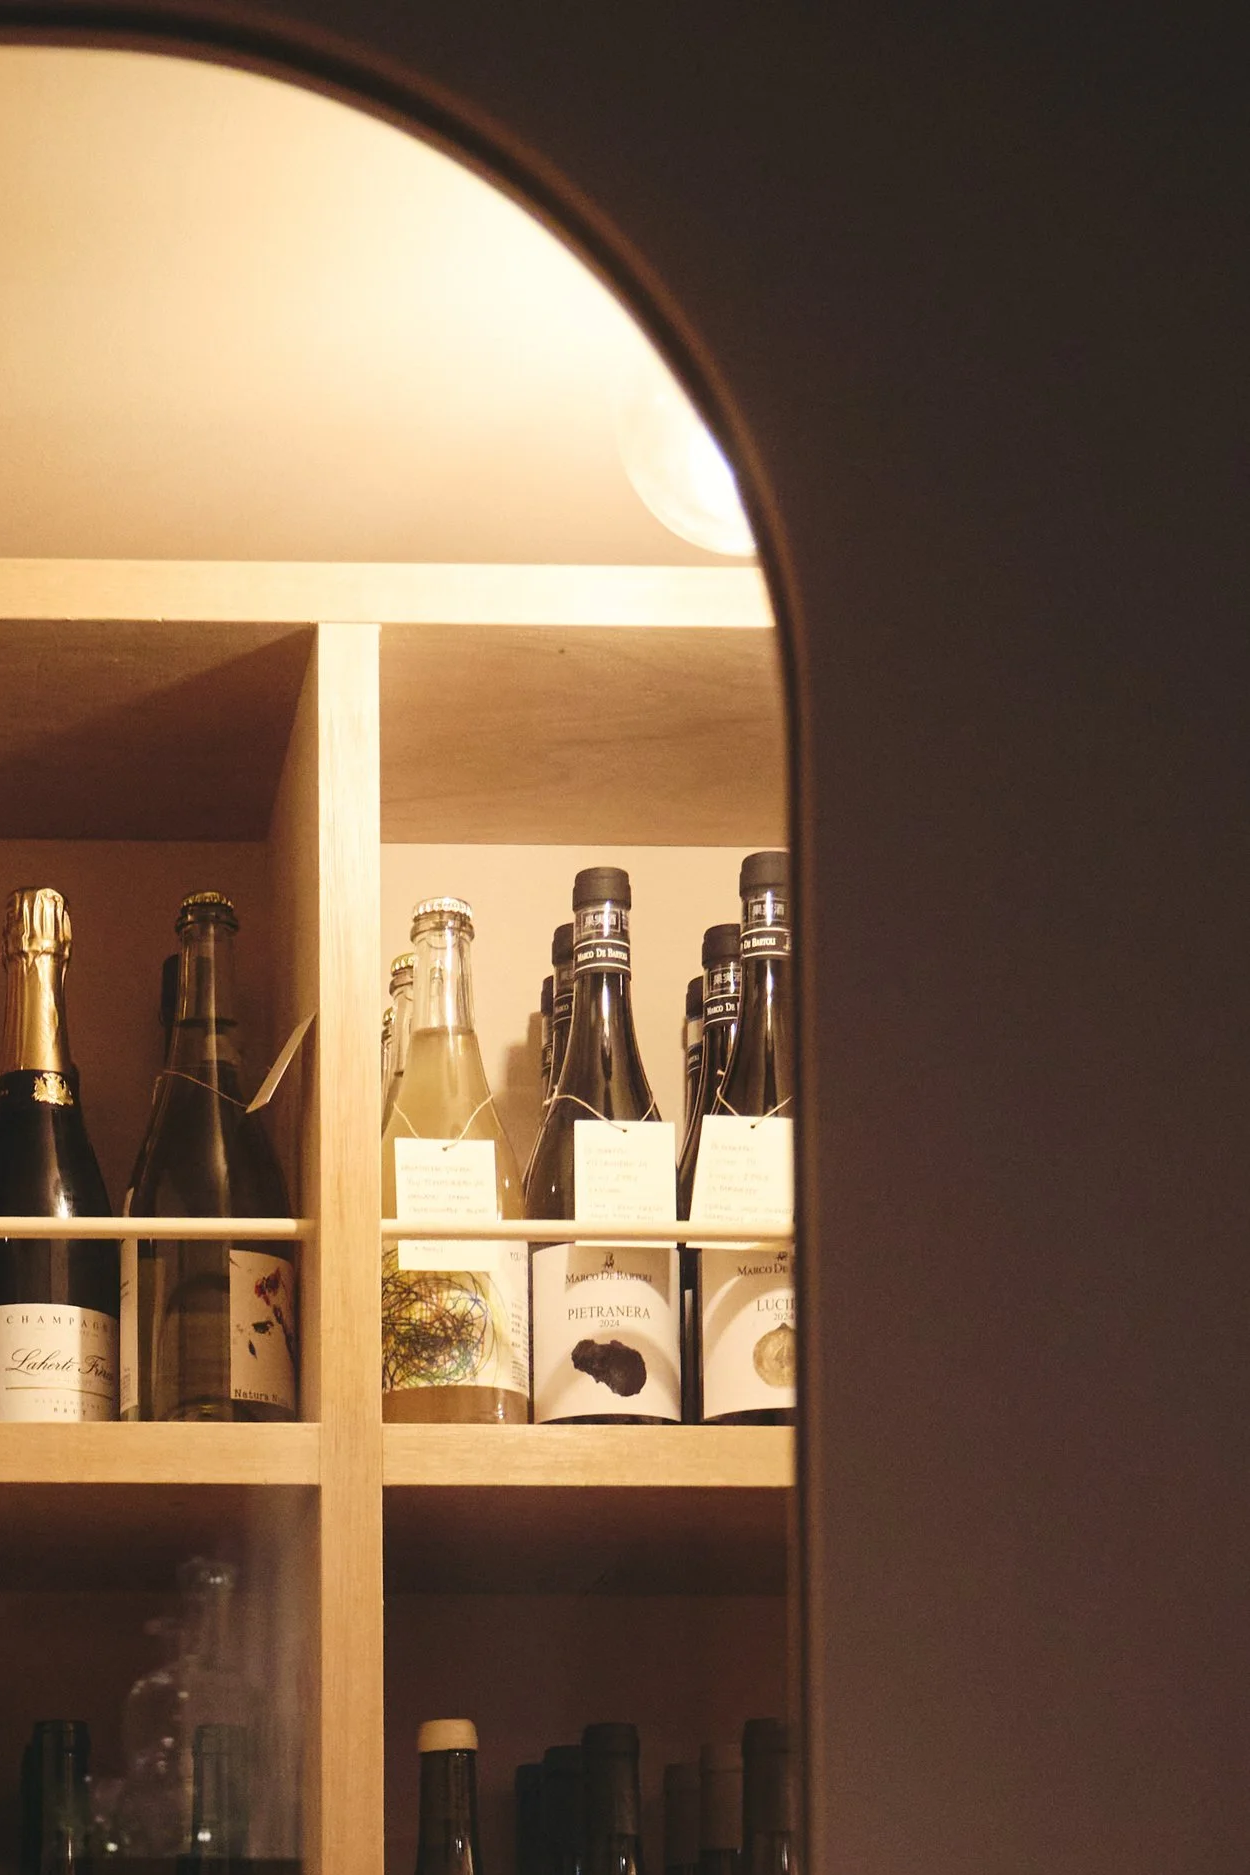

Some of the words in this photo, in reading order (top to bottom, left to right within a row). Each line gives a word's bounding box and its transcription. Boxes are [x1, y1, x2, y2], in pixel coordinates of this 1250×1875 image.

[752, 937, 776, 947] BARTOLI
[596, 948, 607, 959] DE
[737, 1265, 773, 1277] MARCO
[774, 1264, 788, 1274] DE
[566, 1273, 600, 1284] MARCO
[601, 1271, 616, 1281] DE
[617, 1271, 652, 1283] BARTOLI
[567, 1305, 651, 1320] PIETRANERA
[756, 1299, 795, 1313] LUCI
[599, 1319, 621, 1328] 2024
[5, 1348, 77, 1377] Laherte
[234, 1388, 269, 1401] Natura
